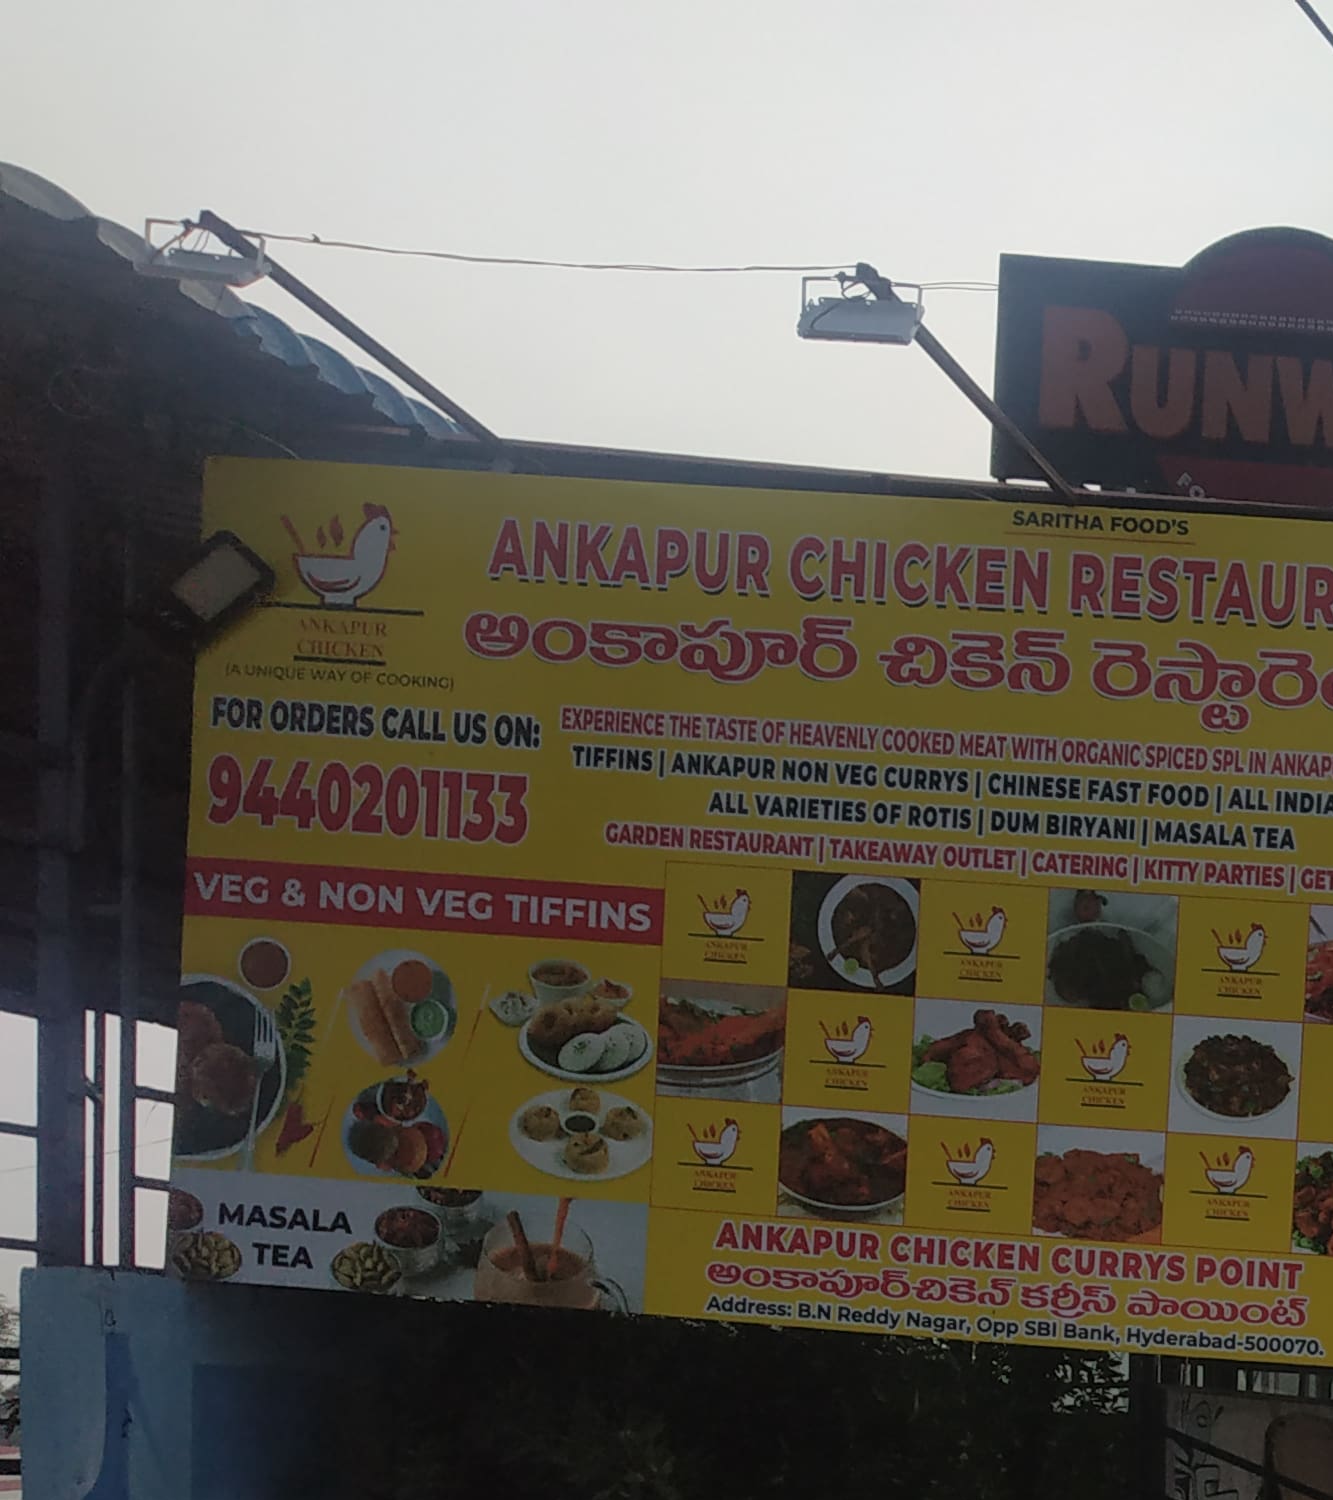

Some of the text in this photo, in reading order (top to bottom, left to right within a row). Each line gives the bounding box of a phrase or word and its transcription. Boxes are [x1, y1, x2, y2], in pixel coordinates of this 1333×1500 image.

[1012, 509, 1189, 535] SARITHA FOOD'S
[488, 519, 770, 599] ANKAPUR
[789, 536, 1048, 611] CHICKEN
[225, 661, 454, 691] (A UNIQUE WAY OF COOKING)
[463, 609, 857, 684] అంకాపూర్
[879, 630, 1071, 694] చికెన్
[211, 696, 540, 748] FOR ORDERS CALL US ON:
[561, 707, 664, 736] EXPERIENCE
[669, 714, 701, 738] THE
[705, 716, 757, 742] TASTE
[761, 720, 785, 743] OF
[789, 721, 878, 750] HEAVENLY
[881, 728, 954, 755] COOKED
[959, 733, 1007, 758] MEAT
[1011, 736, 1057, 761] WITH
[1061, 739, 1141, 767] ORGANIC
[1144, 744, 1208, 770] SPICED
[1211, 748, 1244, 773] SPL
[1248, 750, 1266, 774] IN
[208, 754, 527, 844] 9440201133
[572, 744, 652, 771] TIFFINS
[670, 752, 775, 779] ANKAPUR
[781, 759, 828, 783] NON
[834, 762, 877, 787] VEG
[883, 765, 968, 792] CURRYS
[987, 772, 1081, 799] CHINESE
[1087, 779, 1141, 803] FAST
[1147, 783, 1209, 807] FOOD
[1227, 787, 1268, 811] ALL
[708, 791, 1294, 850] ALL VARIETIES OF ROTIS DUM BIRYANI MASALA TEA
[605, 822, 683, 848] GARDEN
[689, 828, 814, 856] RESTAURANT
[828, 837, 938, 865] TAKEAWAY
[942, 845, 1016, 870] OUTLET
[1031, 851, 1127, 878] CATERING
[1143, 858, 1199, 882] KITTY
[1203, 862, 1284, 888] PARTIES
[193, 871, 651, 931] VEG & NON VEG TIFFINS
[218, 1202, 352, 1234] MASALA
[251, 1242, 313, 1269] TEA
[715, 1221, 1303, 1289] ANKAPUR CHICKEN CURRYS POINT
[706, 1295, 1324, 1355] Address: B.N Reddy Nagar, Opp SBI Bank, Hyderabad-500070.
